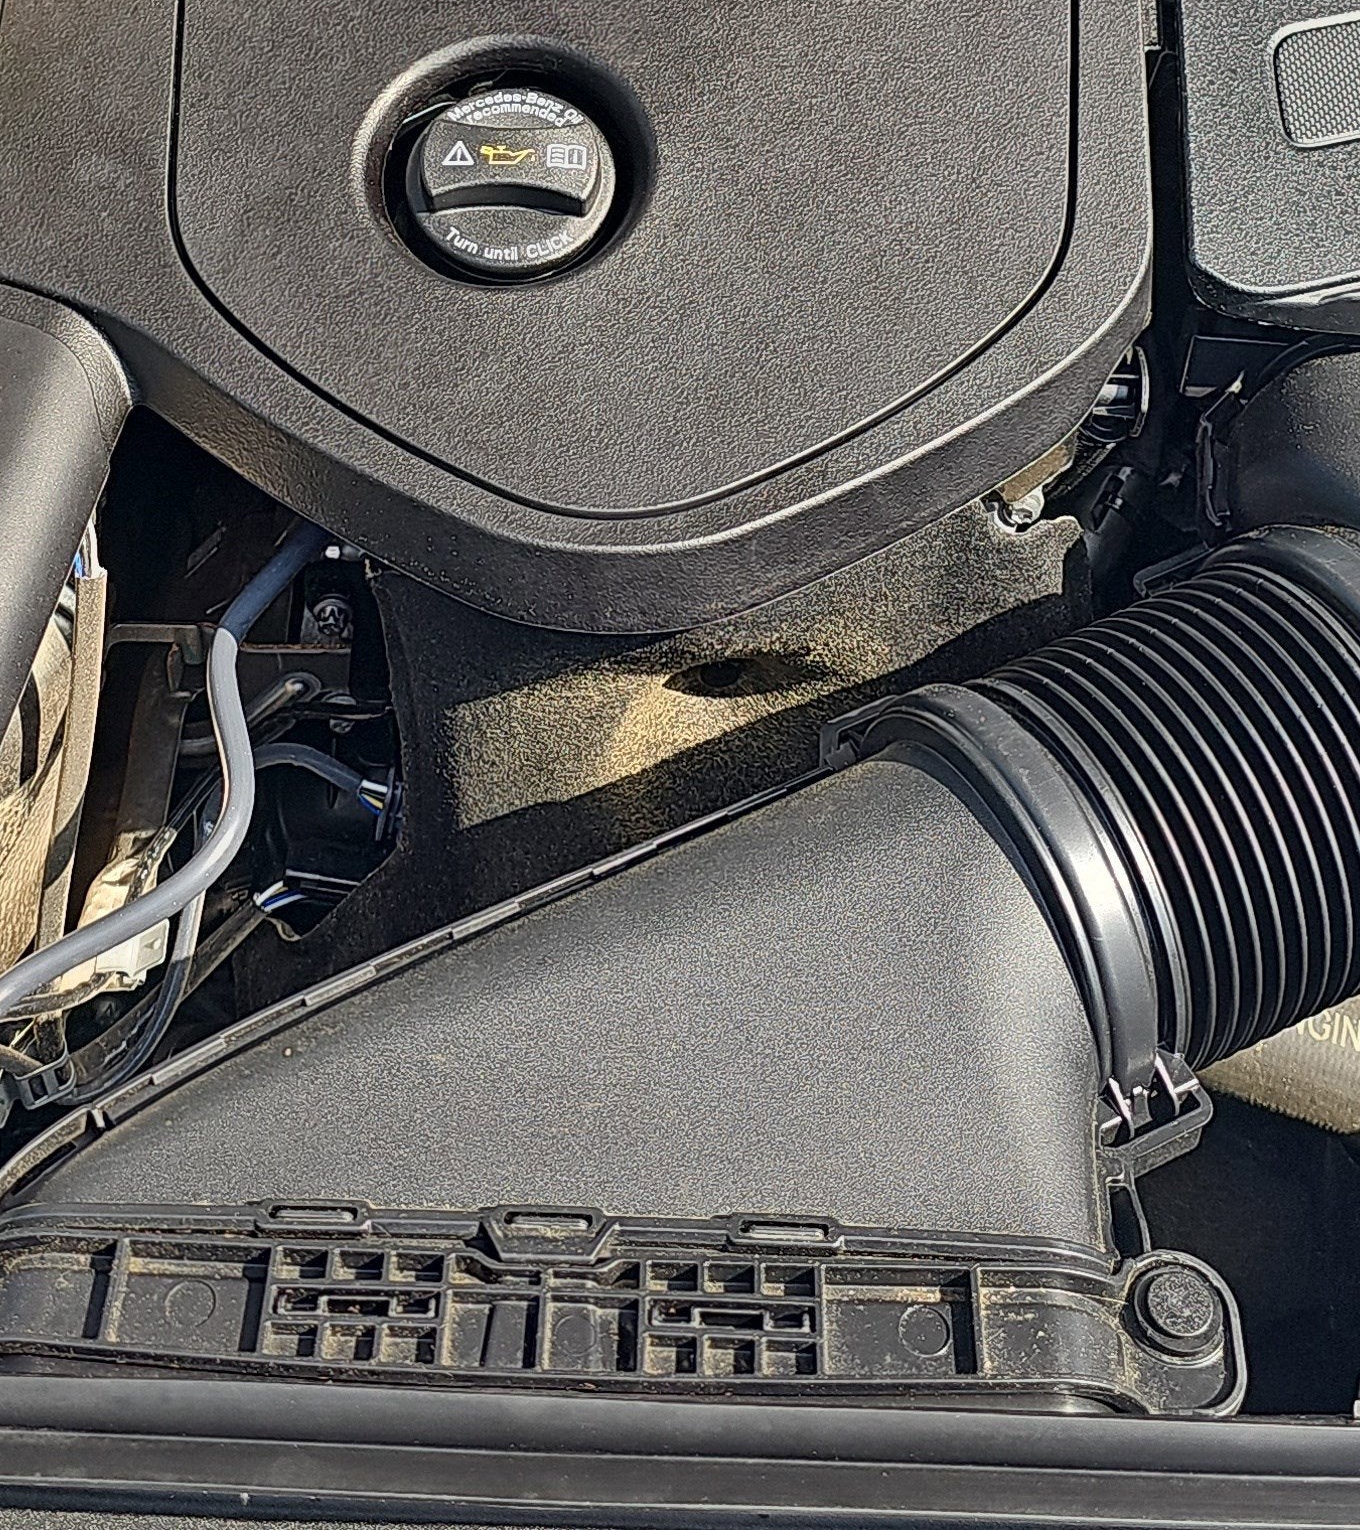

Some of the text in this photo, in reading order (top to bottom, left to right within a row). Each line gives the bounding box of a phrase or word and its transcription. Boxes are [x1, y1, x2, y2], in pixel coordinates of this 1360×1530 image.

[446, 91, 563, 121] Mercedes-Benz
[466, 102, 568, 127] recommended
[444, 226, 574, 260] Turn until CLICK
